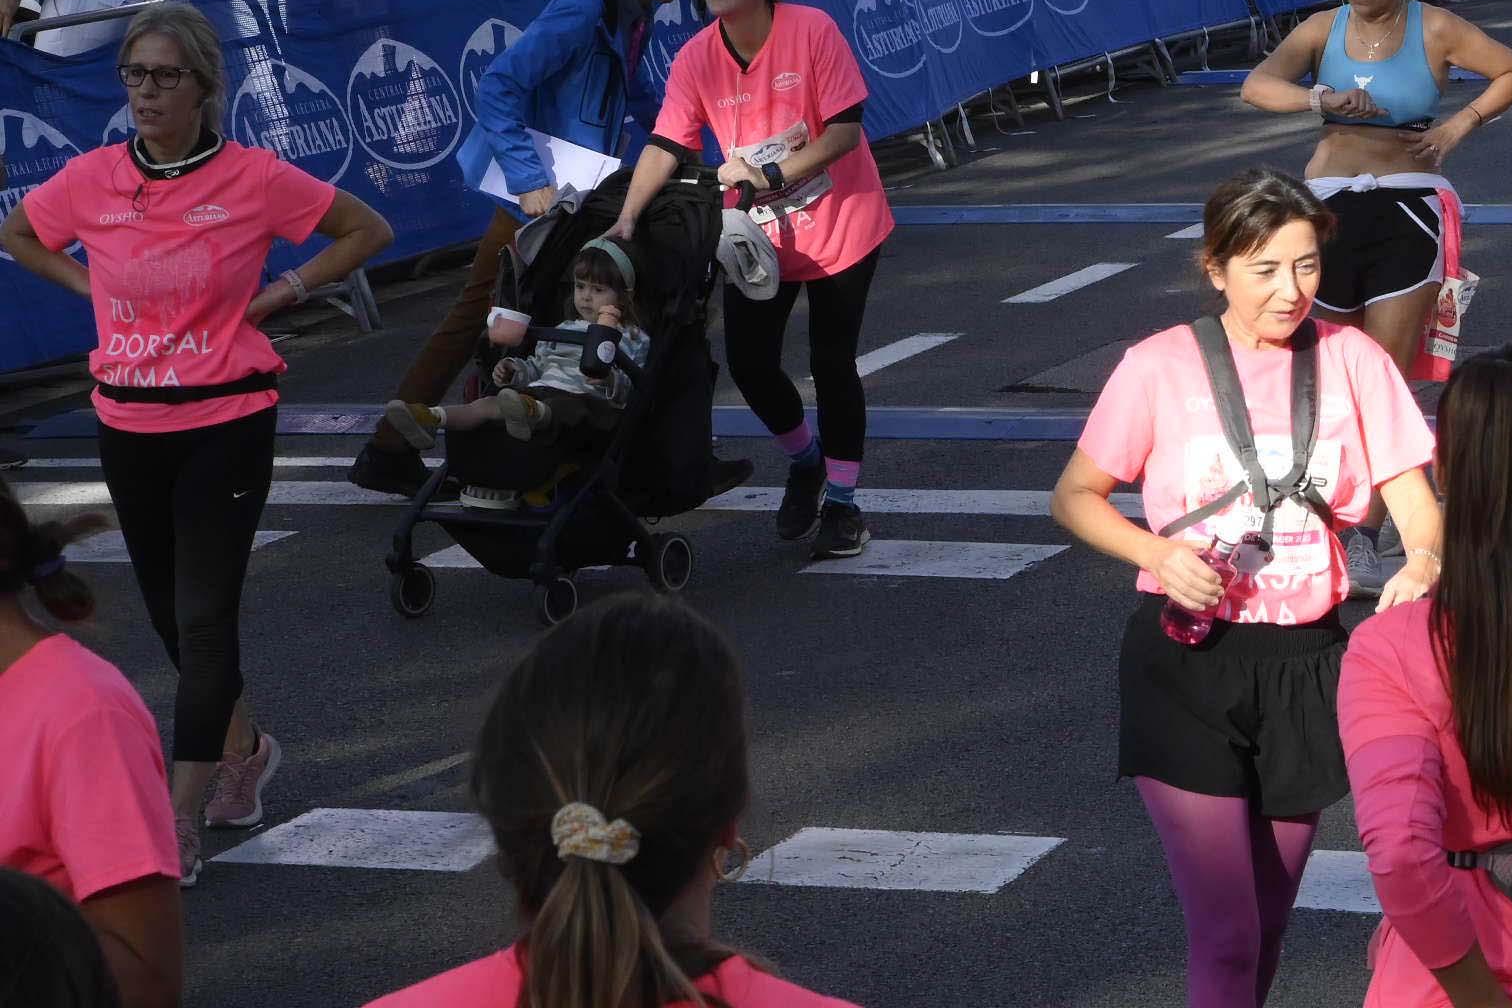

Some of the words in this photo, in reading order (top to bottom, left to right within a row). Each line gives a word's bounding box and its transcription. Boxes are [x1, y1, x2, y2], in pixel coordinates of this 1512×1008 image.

[99, 211, 144, 225] OYSHO
[111, 297, 136, 324] TU
[105, 330, 214, 359] DORSAL
[102, 363, 182, 388] SUMA
